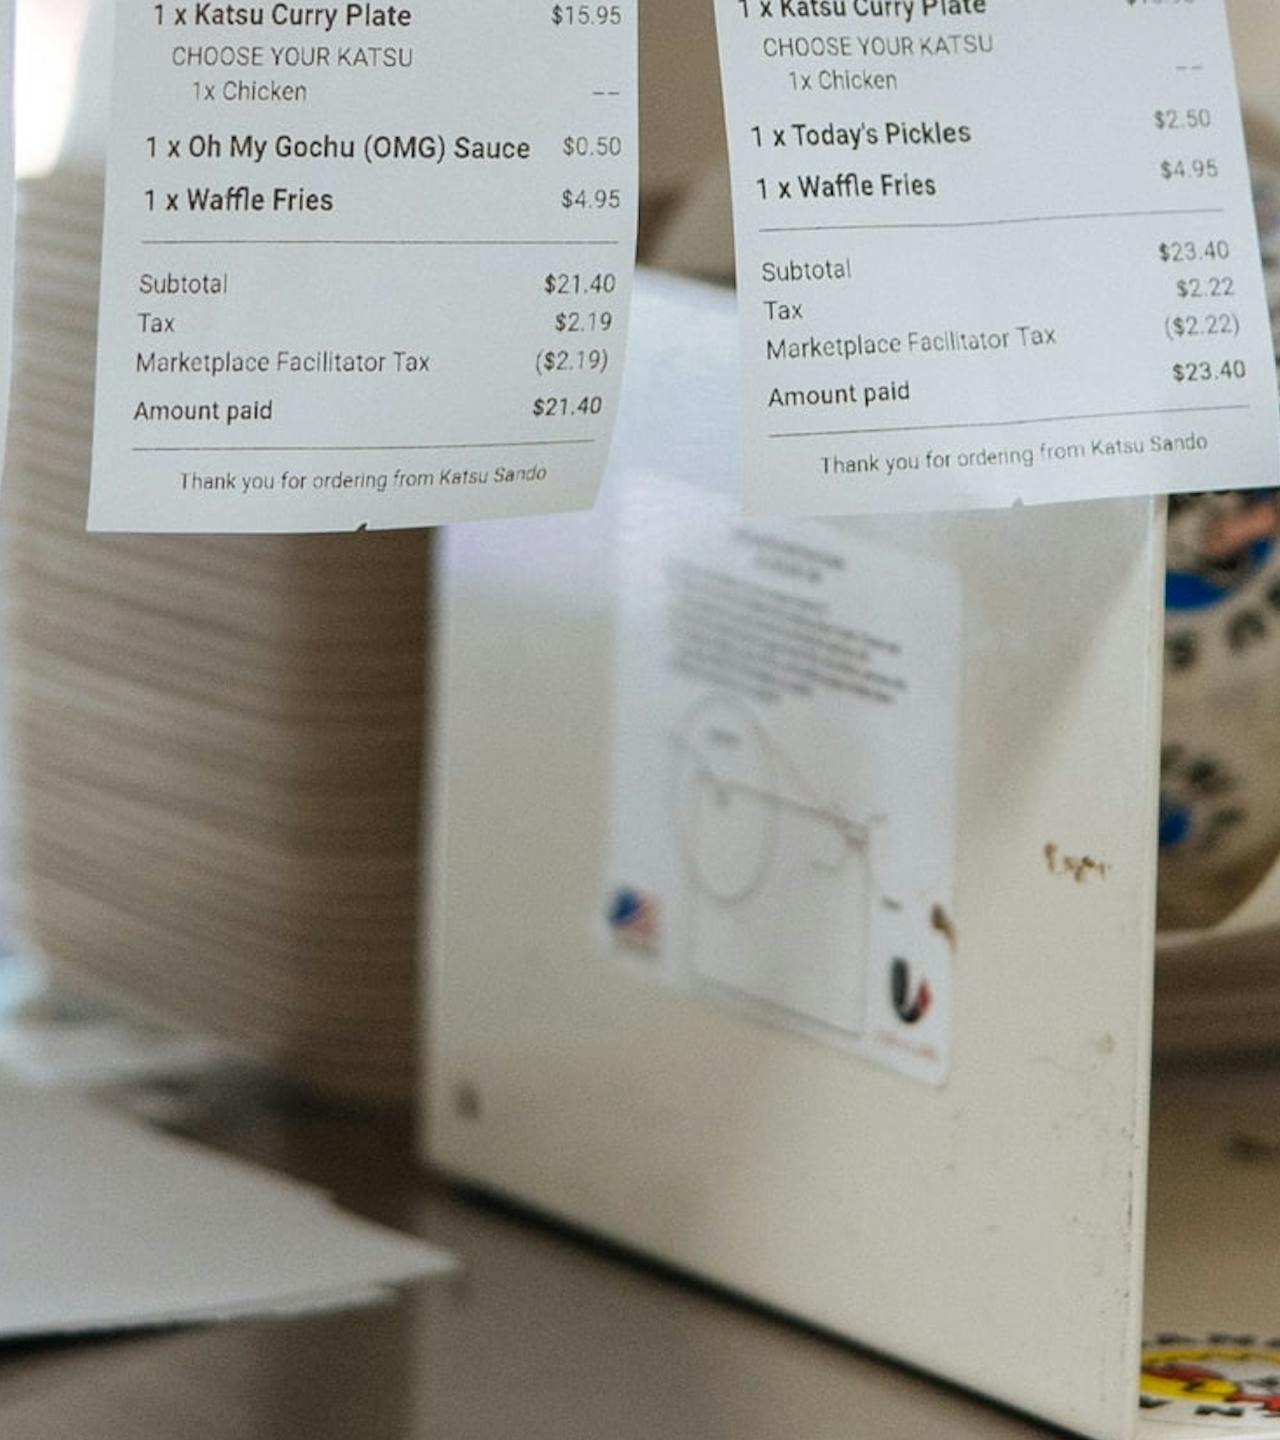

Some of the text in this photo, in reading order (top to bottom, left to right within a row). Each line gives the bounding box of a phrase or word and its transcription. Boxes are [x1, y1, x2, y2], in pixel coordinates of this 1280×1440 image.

[154, 2, 621, 32] 1 x Katsu Curry Plate $15.95
[760, 1, 773, 17] x
[172, 46, 413, 67] CHOOSE YOUR KATSU
[763, 34, 993, 57] CHOOSE YOUR KATSU
[193, 80, 307, 101] 1x Chicken
[789, 69, 897, 91] 1x Chicken
[751, 109, 1211, 151] 1 x Today's Pickles $2.50
[147, 134, 621, 164] 1 x Oh My Gochu (OMG) Sauce $0.50
[757, 158, 1218, 200] 1 x Waffle Fries $4.95
[145, 186, 620, 211] 1 x Waffle Fries $4.95
[139, 272, 616, 295] Subtotal $21.40
[138, 311, 612, 333] Tax $2.19
[136, 349, 608, 377] Marketplace Facilitator Tax ($2.19)
[768, 360, 1246, 408] Amount paid $23.40
[133, 396, 602, 426] Amount paid $21.40
[182, 465, 547, 494] Thank you for ordering from Katsu Sando
